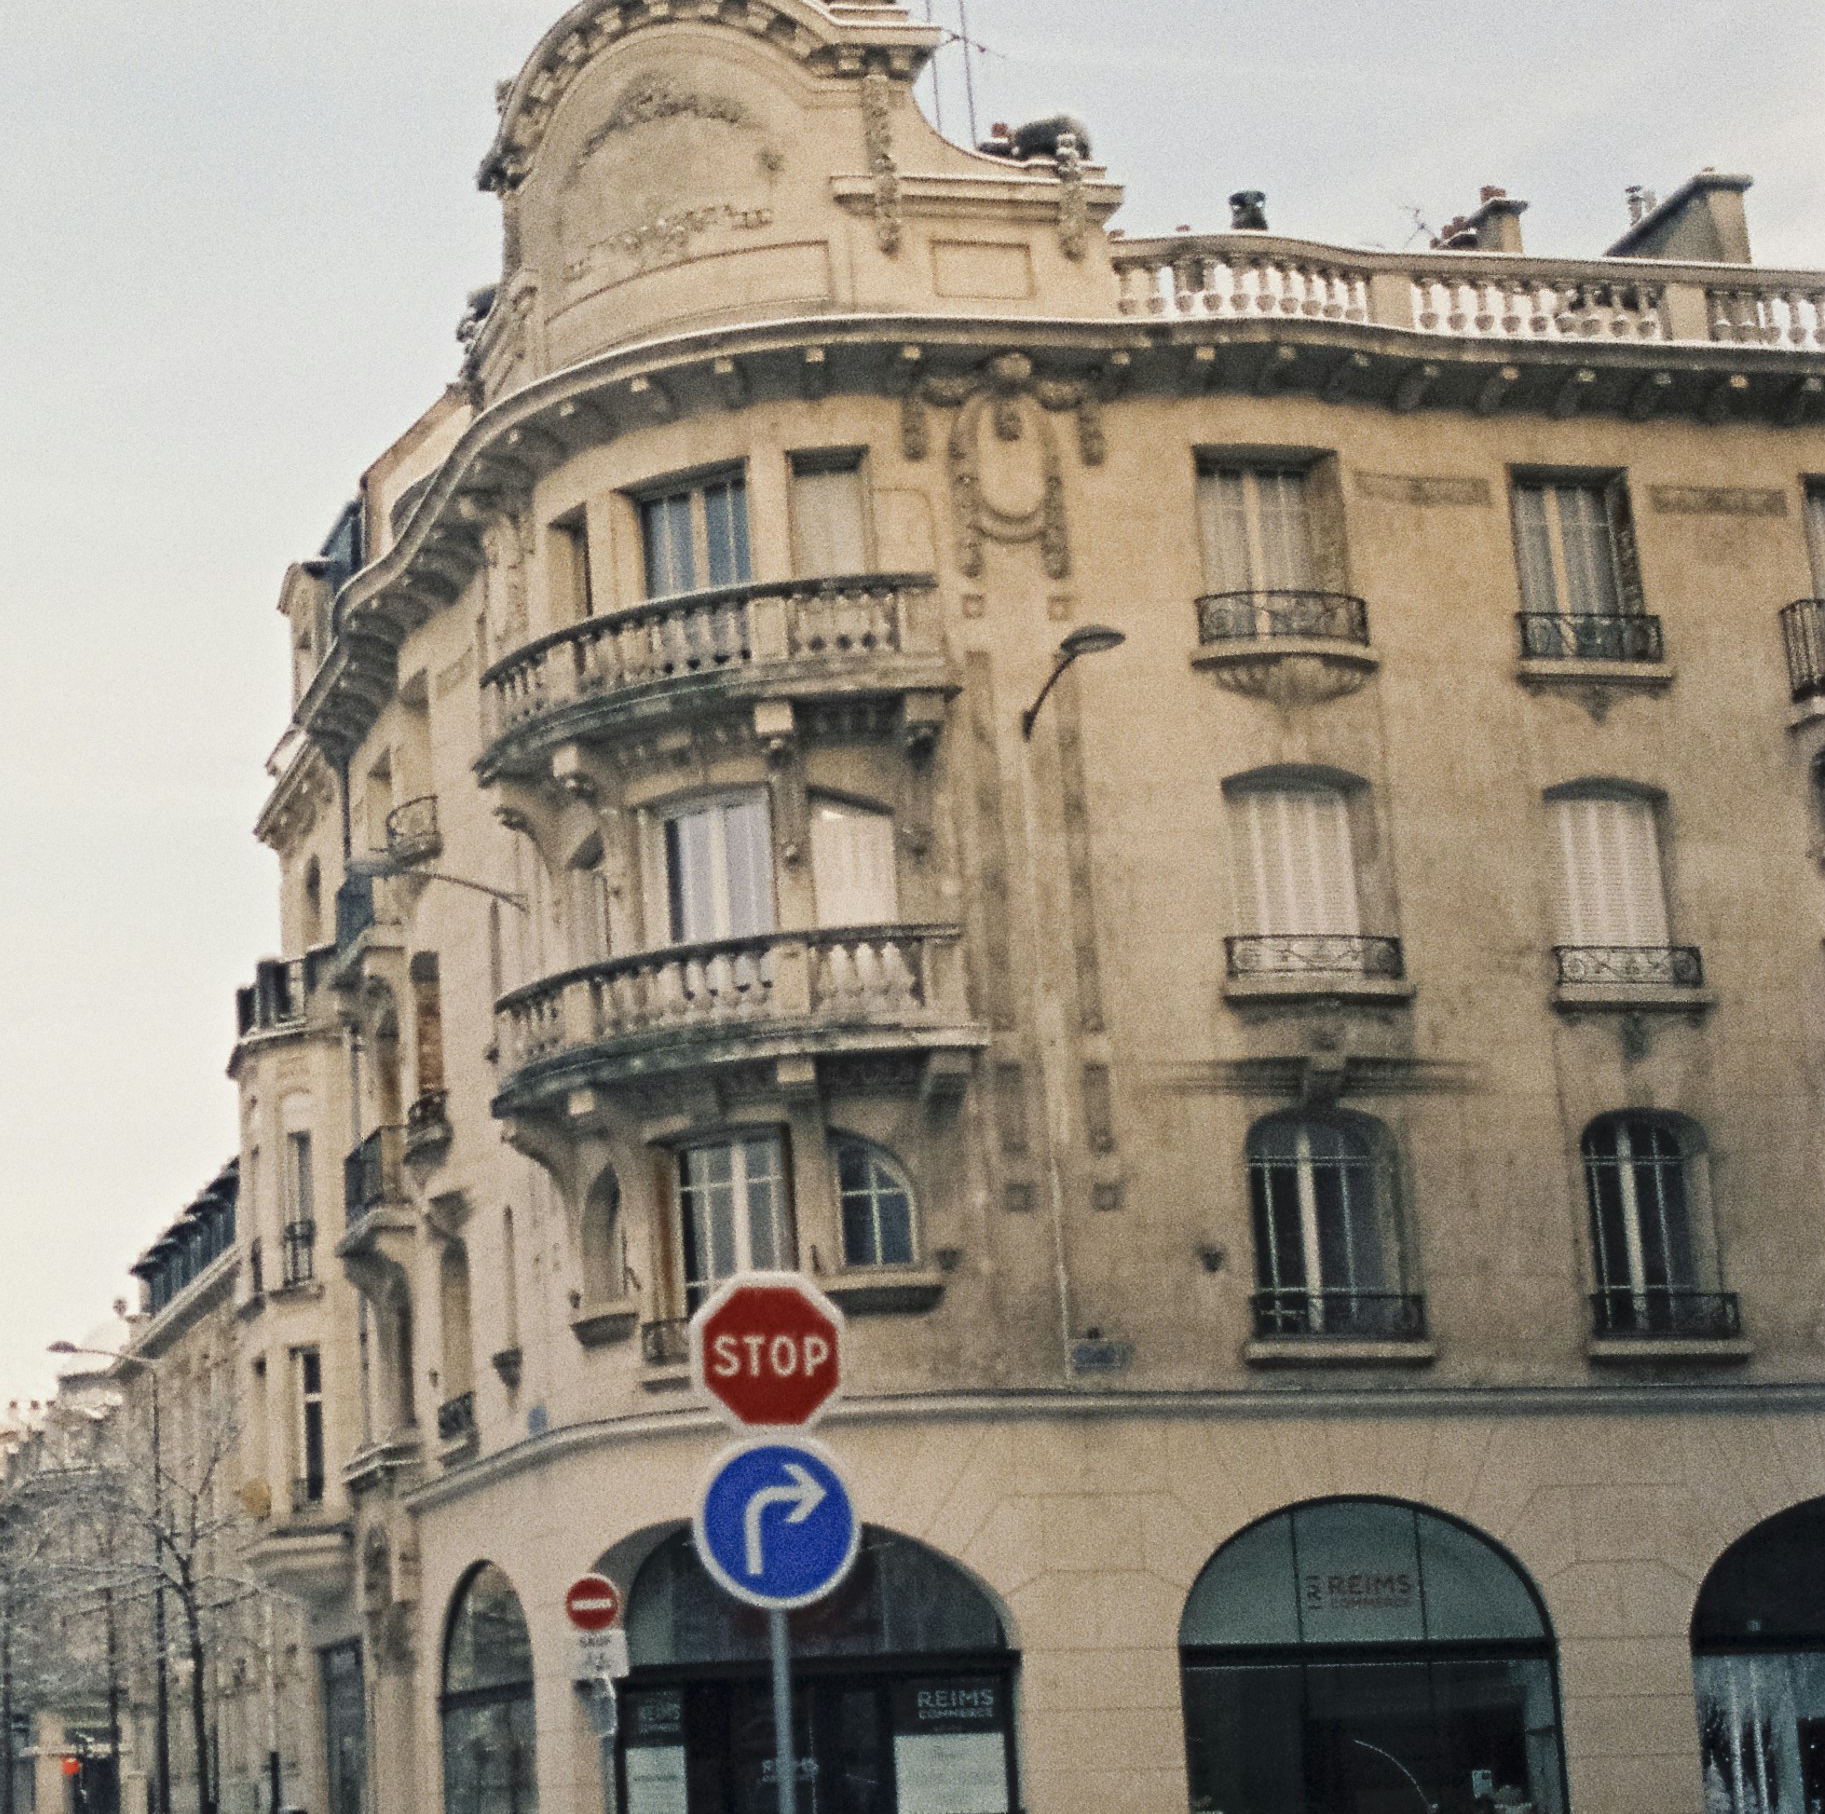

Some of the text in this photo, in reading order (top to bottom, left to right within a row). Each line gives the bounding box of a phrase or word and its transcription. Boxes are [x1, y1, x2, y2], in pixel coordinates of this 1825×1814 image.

[713, 1334, 829, 1377] STOP
[1327, 1573, 1411, 1595] REIMS
[917, 1688, 995, 1707] REIMS
[918, 1707, 993, 1720] COMMERCE
